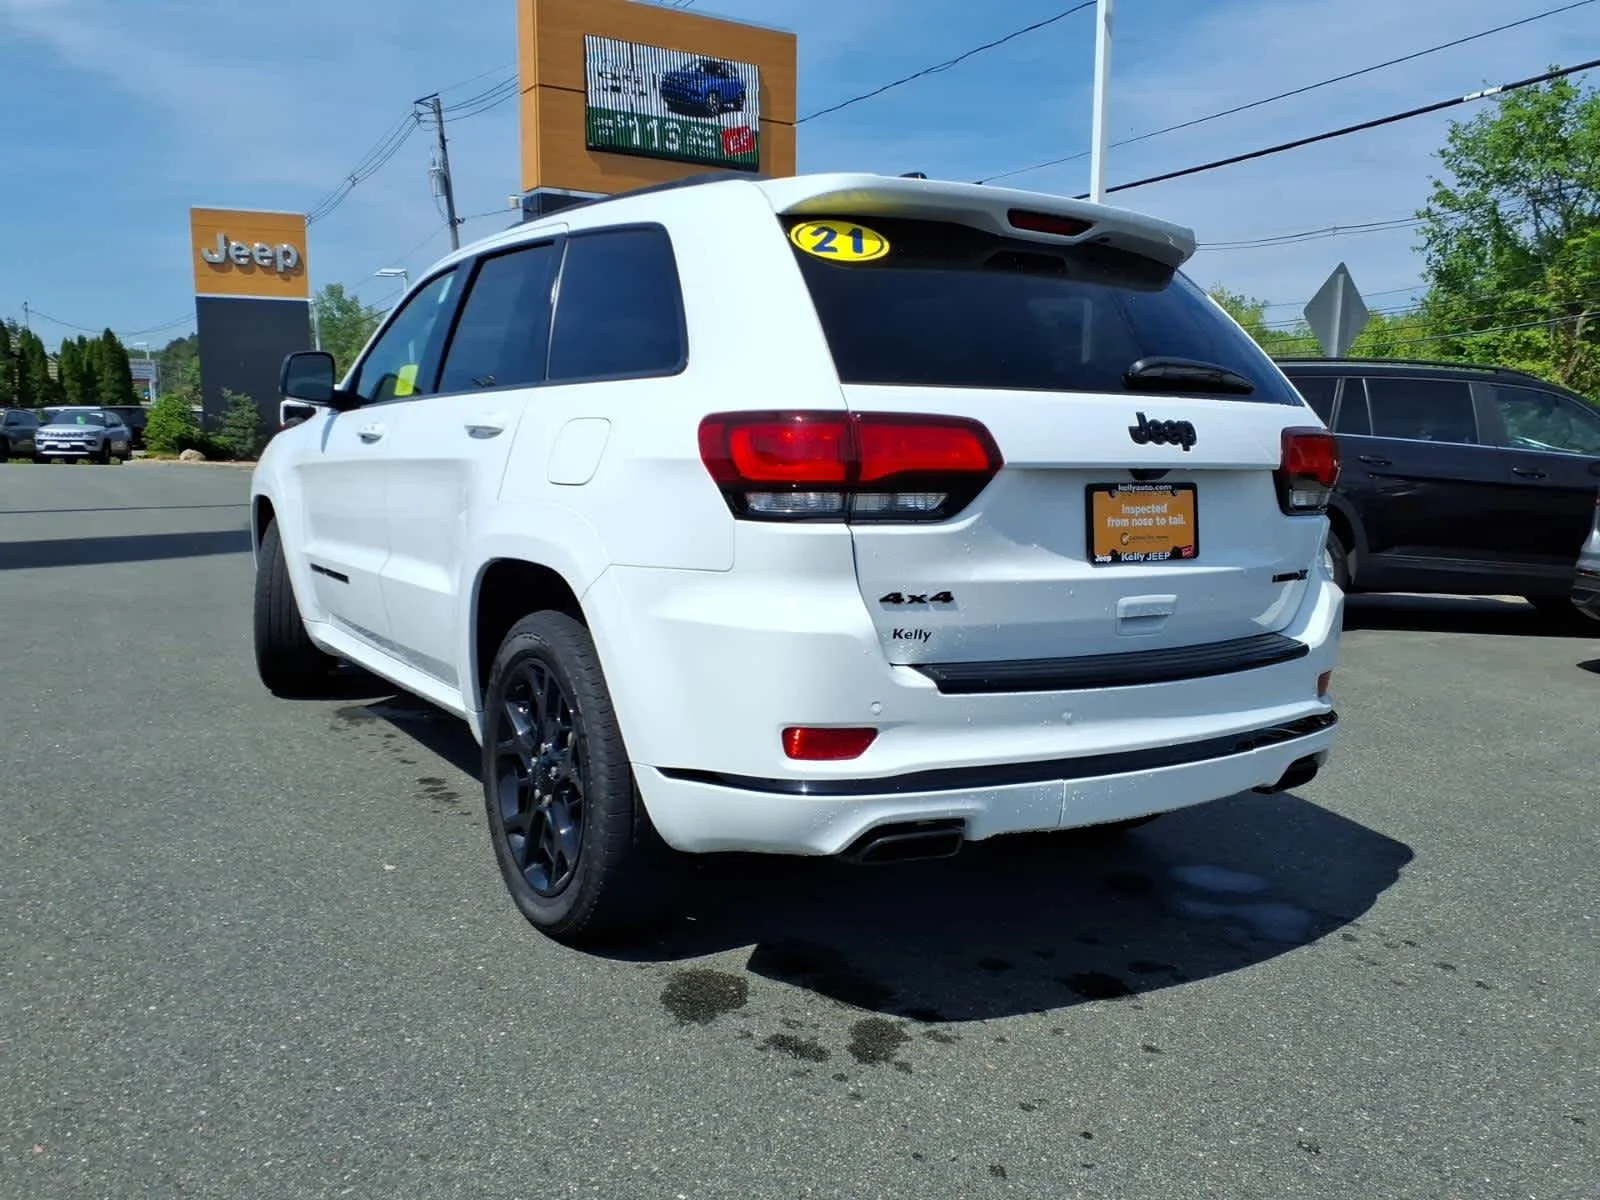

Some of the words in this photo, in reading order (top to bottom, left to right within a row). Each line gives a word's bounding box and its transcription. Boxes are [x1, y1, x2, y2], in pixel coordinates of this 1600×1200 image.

[810, 226, 865, 254] 21
[201, 233, 299, 273] Jeep
[1128, 412, 1197, 451] Jeep
[1118, 484, 1172, 493] kellyauto.com
[1122, 504, 1168, 516] Inspected
[1107, 517, 1129, 527] from
[1131, 517, 1153, 527] nose
[1156, 516, 1167, 526] to
[1095, 553, 1112, 562] Jeep
[1121, 552, 1145, 562] Kelly
[1146, 551, 1170, 561] JEEP
[892, 628, 932, 643] Kelly
